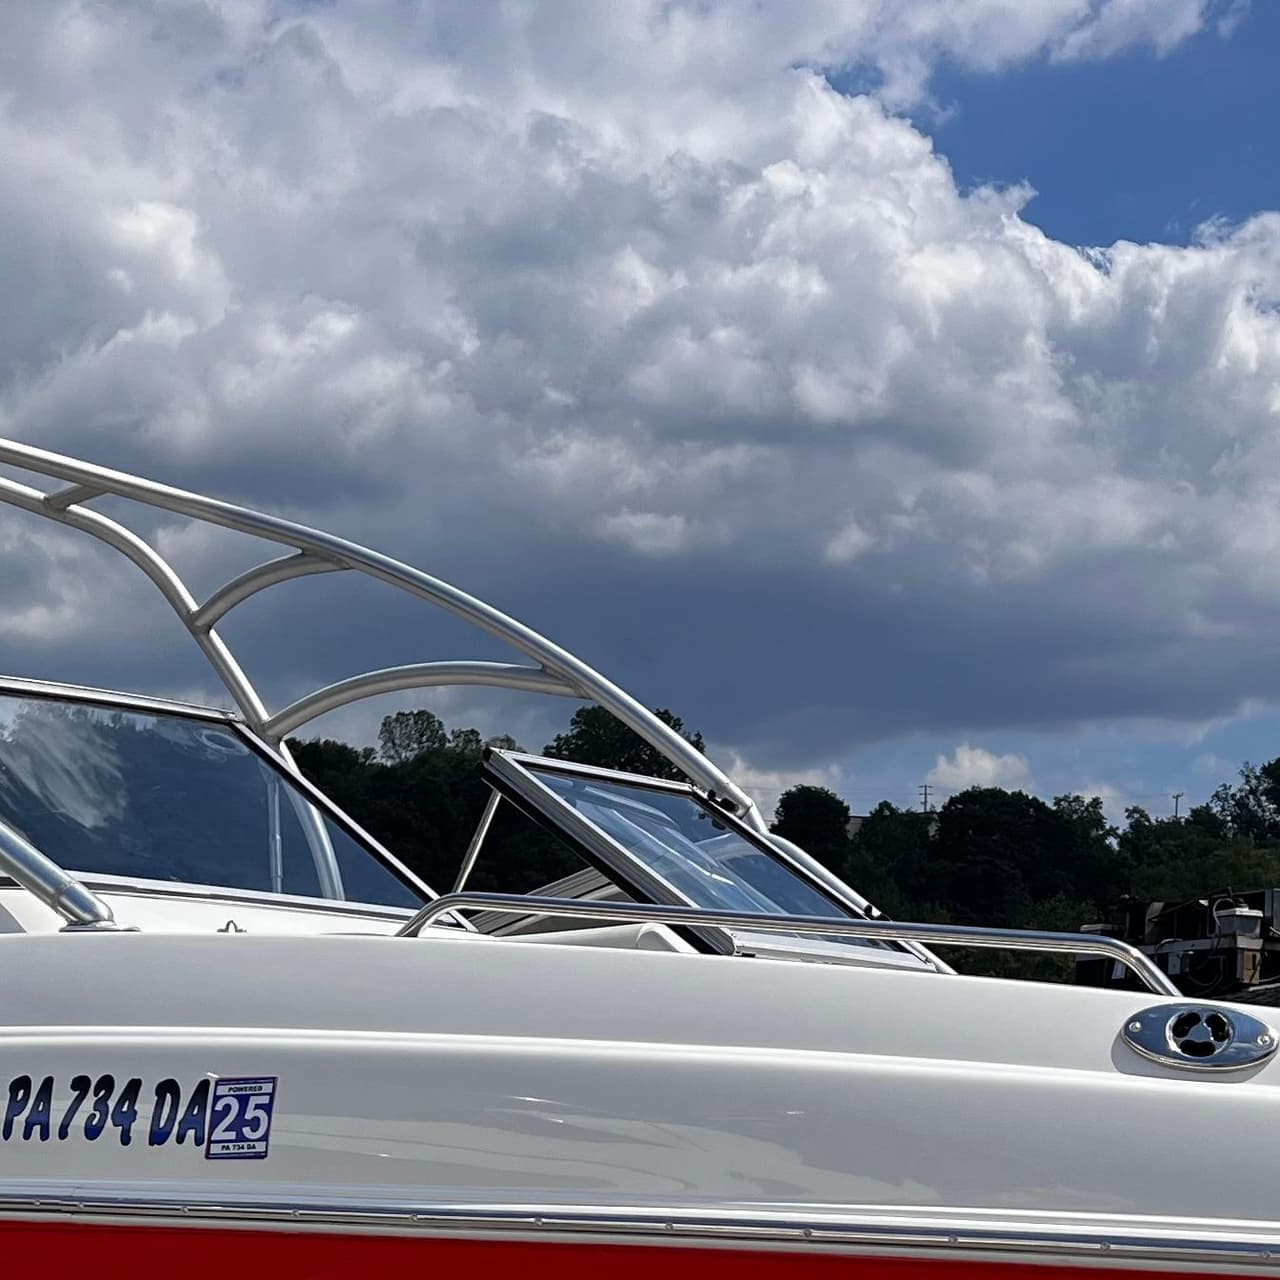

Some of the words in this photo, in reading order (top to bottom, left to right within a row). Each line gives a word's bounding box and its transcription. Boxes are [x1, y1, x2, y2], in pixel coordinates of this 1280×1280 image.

[227, 1085, 263, 1093] POWERED
[1, 1074, 55, 1142] PA
[57, 1073, 143, 1147] 734
[148, 1077, 211, 1147] DA
[210, 1095, 270, 1141] 25
[221, 1144, 231, 1152] PA
